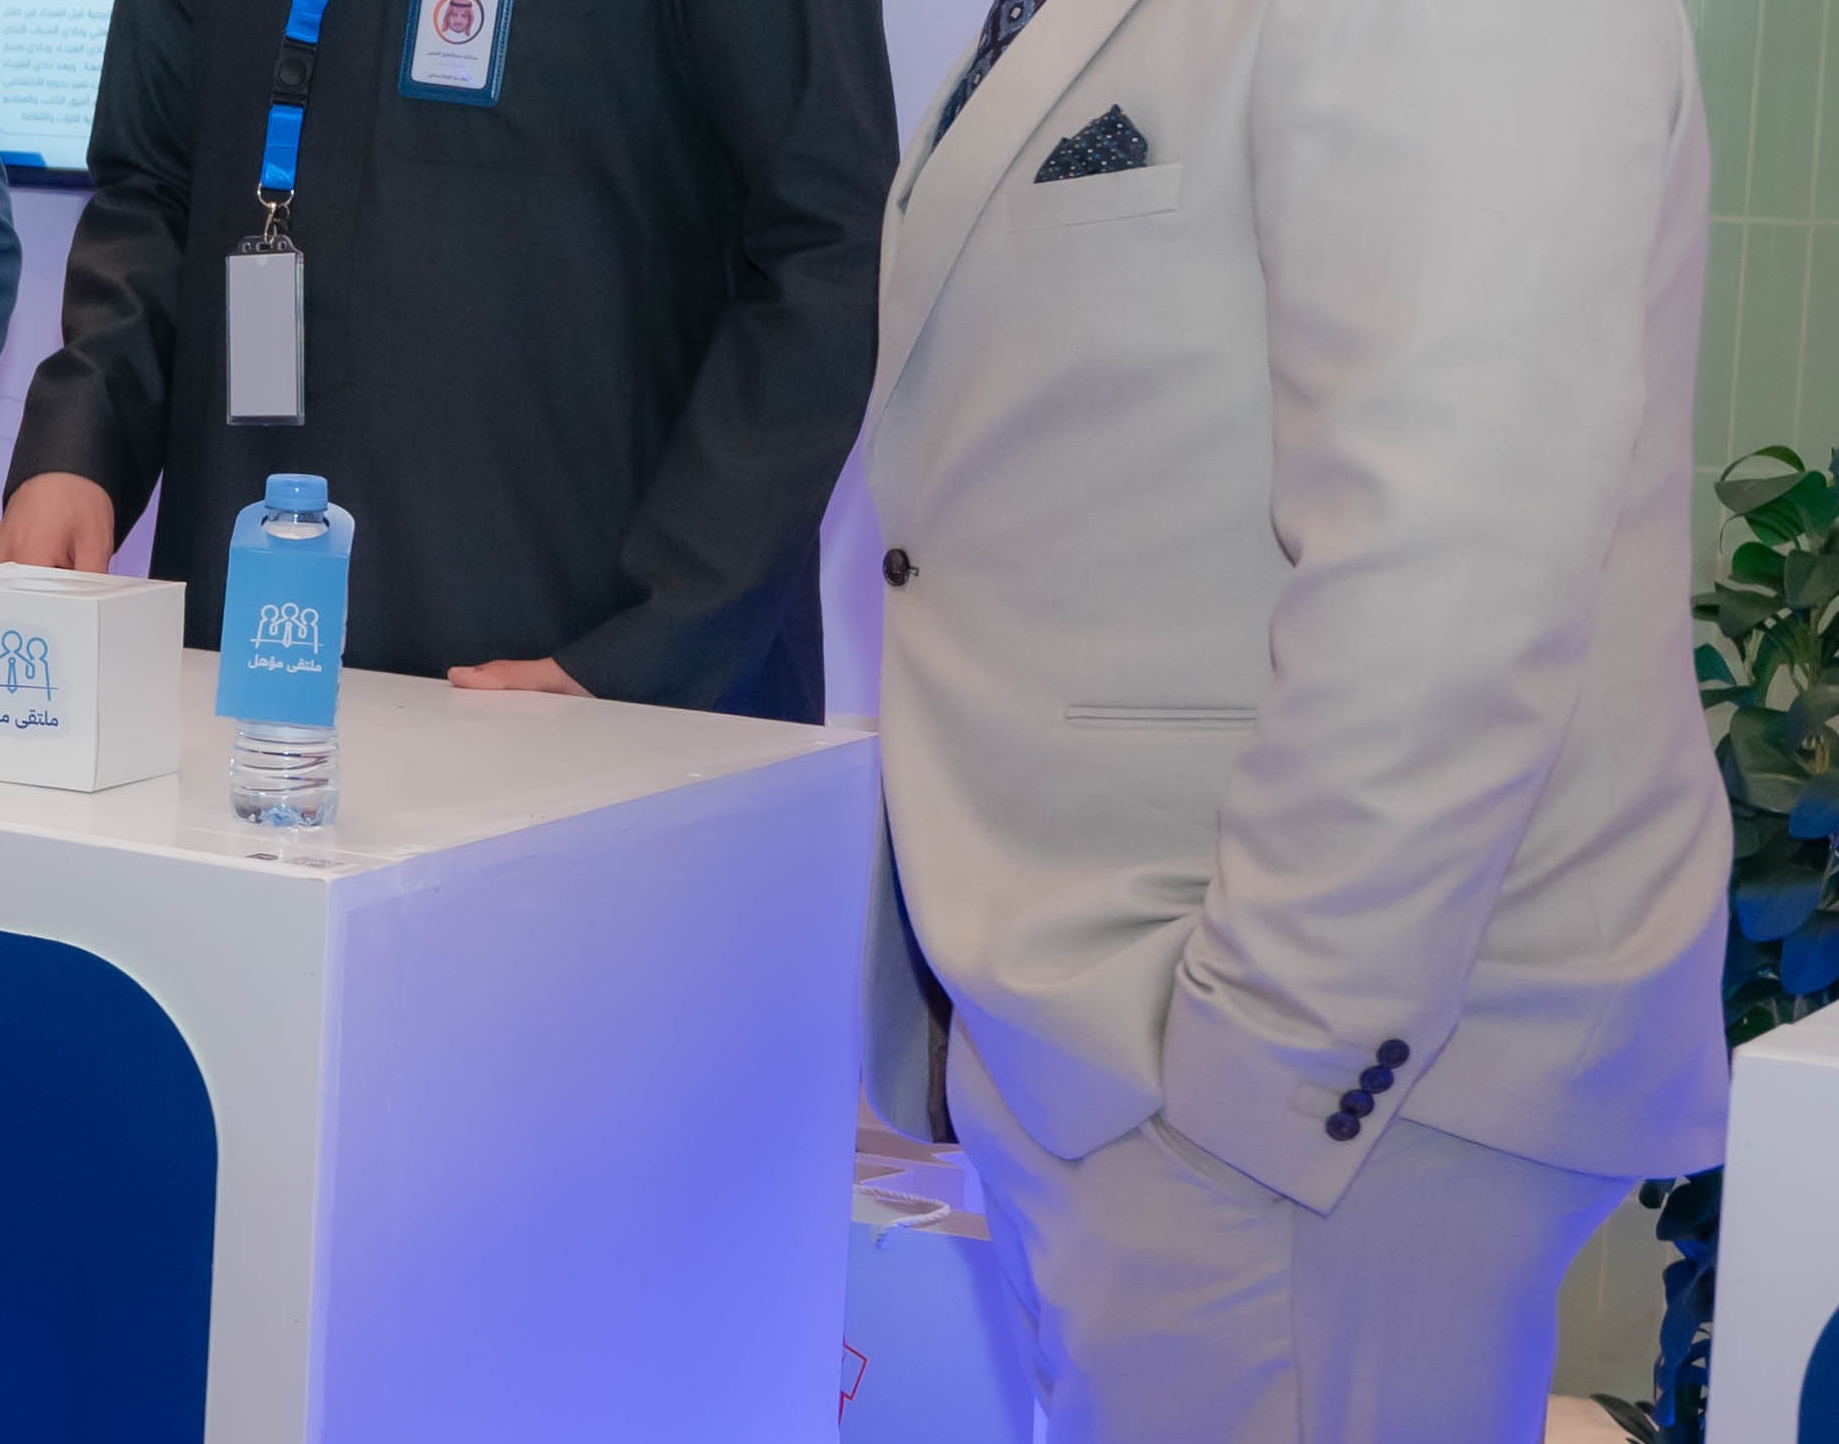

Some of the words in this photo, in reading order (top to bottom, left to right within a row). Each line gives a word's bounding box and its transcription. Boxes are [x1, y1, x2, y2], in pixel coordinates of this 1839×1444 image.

[247, 654, 284, 671] مؤهل
[286, 658, 322, 673] ملتقى
[15, 709, 59, 729] ملتقى
